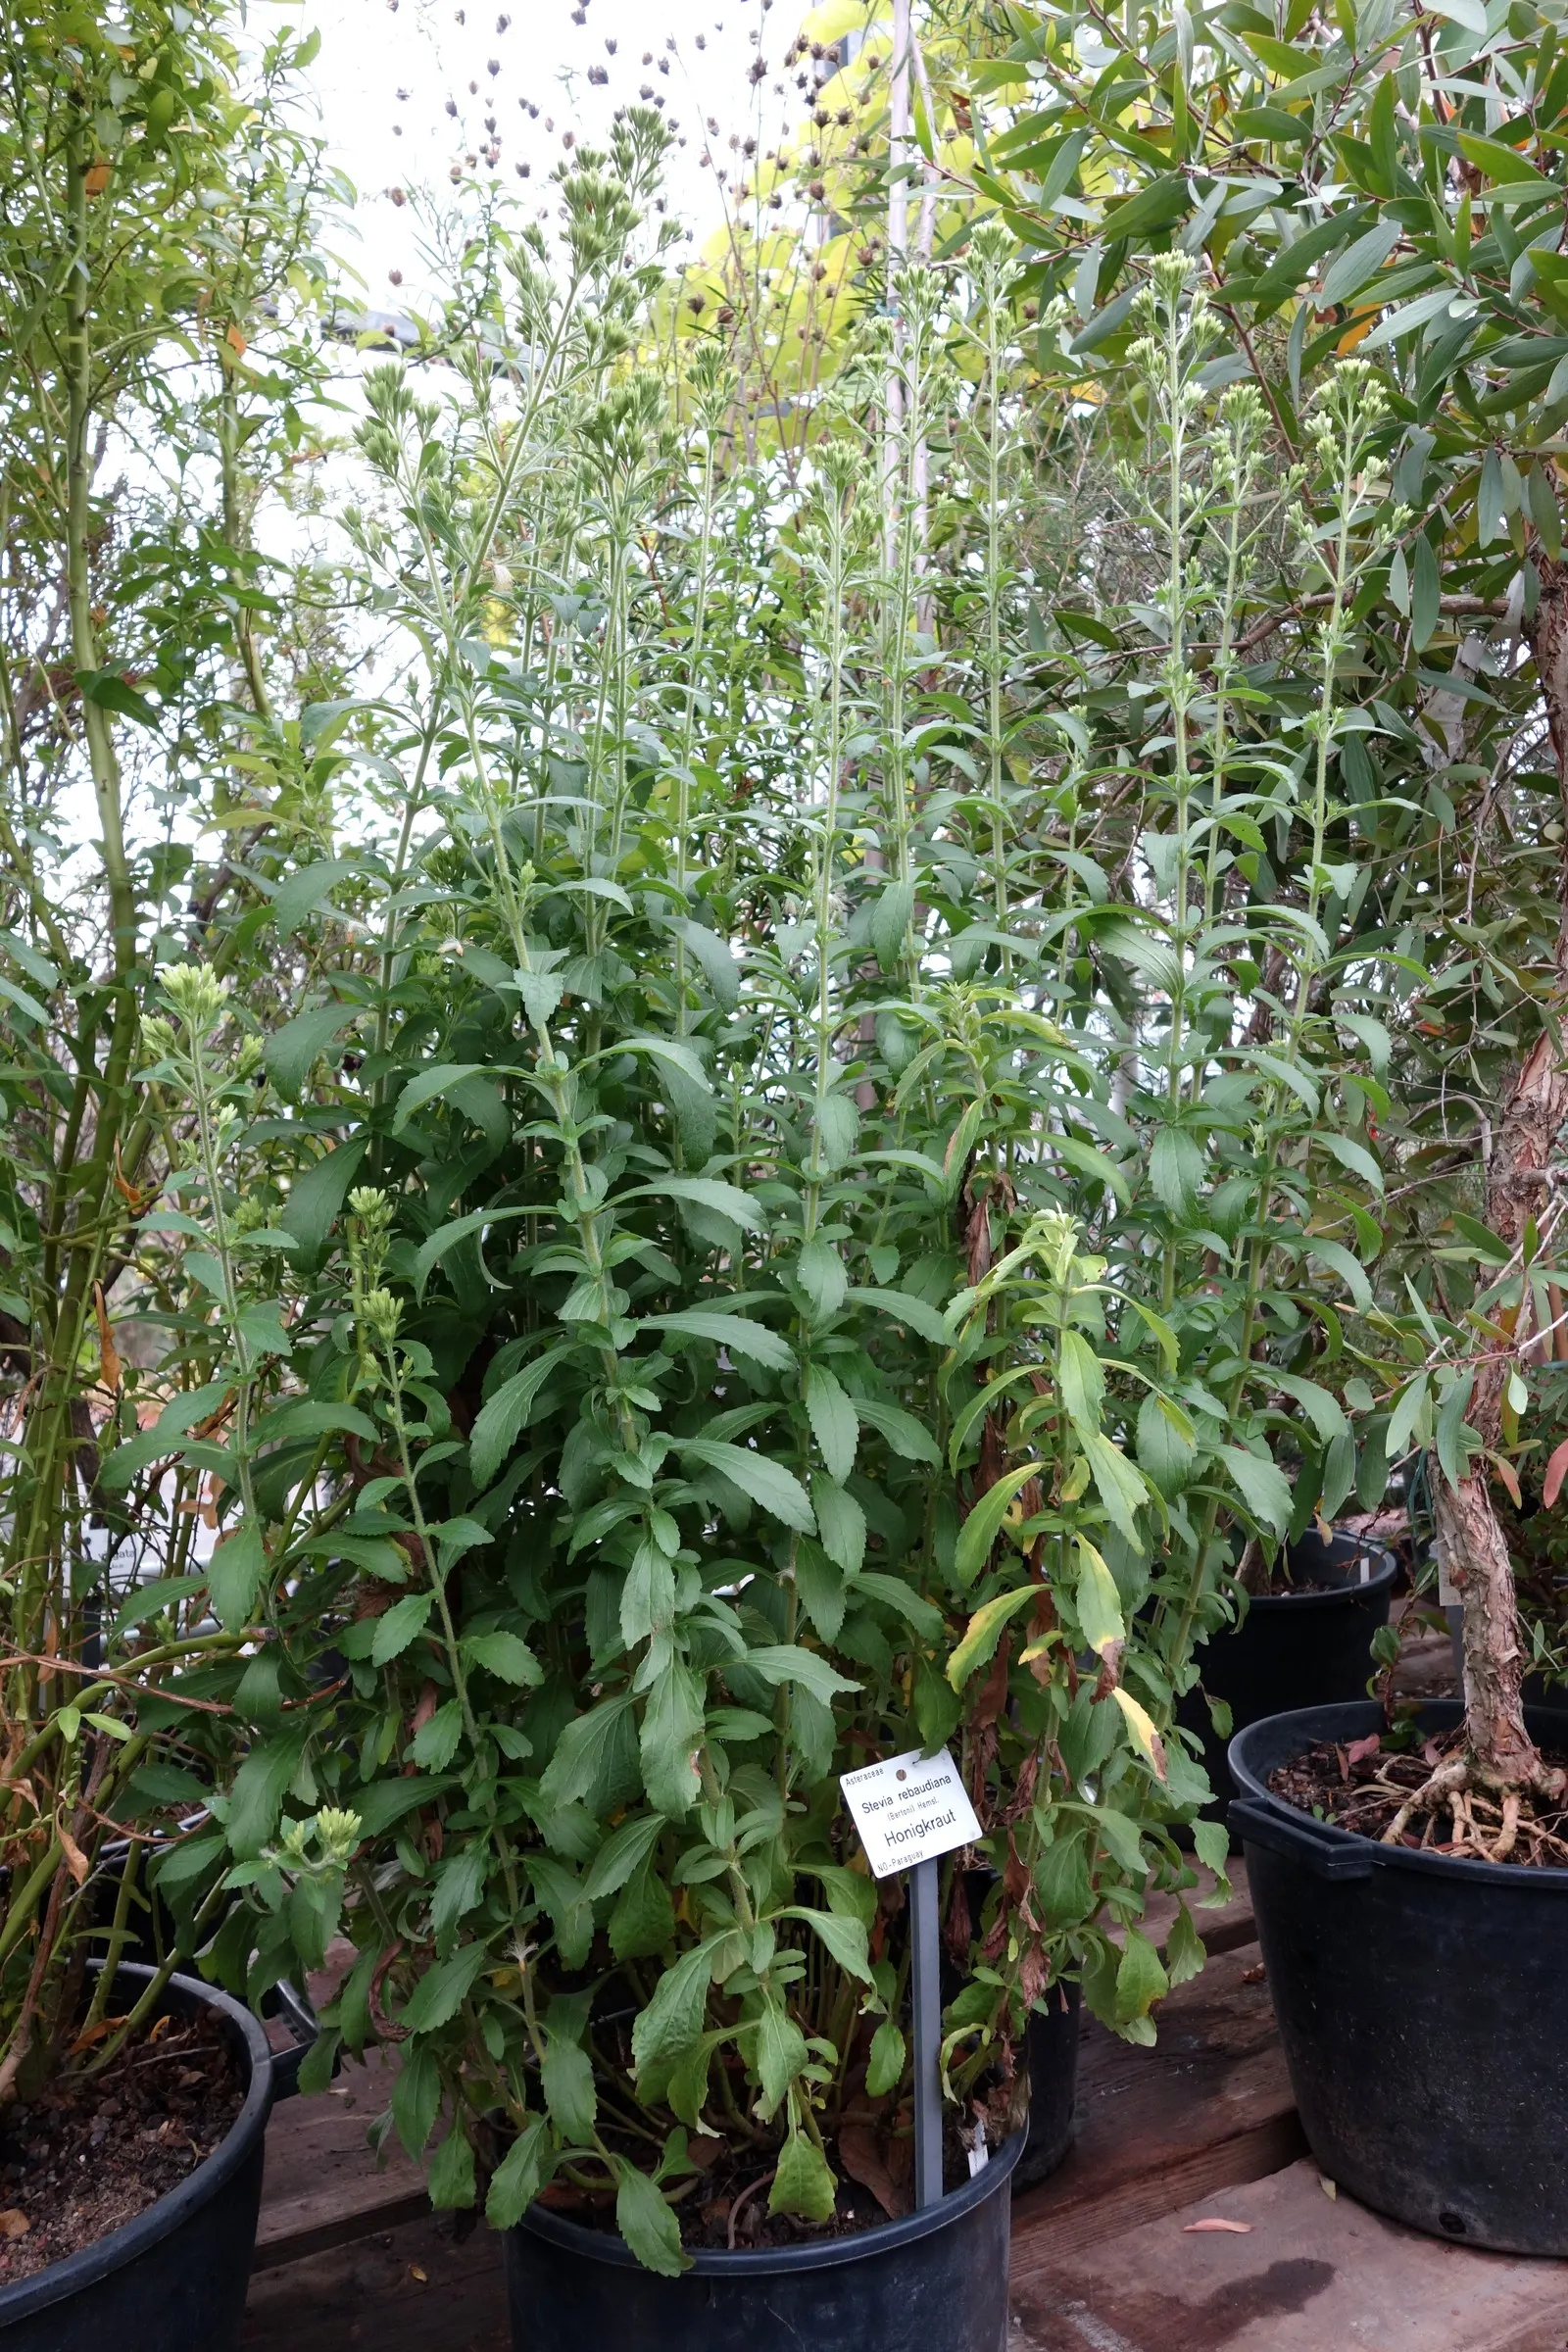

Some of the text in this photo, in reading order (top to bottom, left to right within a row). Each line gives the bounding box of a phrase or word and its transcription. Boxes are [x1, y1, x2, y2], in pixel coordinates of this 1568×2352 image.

[845, 1767, 884, 1787] Asteraceae
[861, 1775, 952, 1814] Stevia rebaudiana
[884, 1809, 956, 1846] Honigkraut
